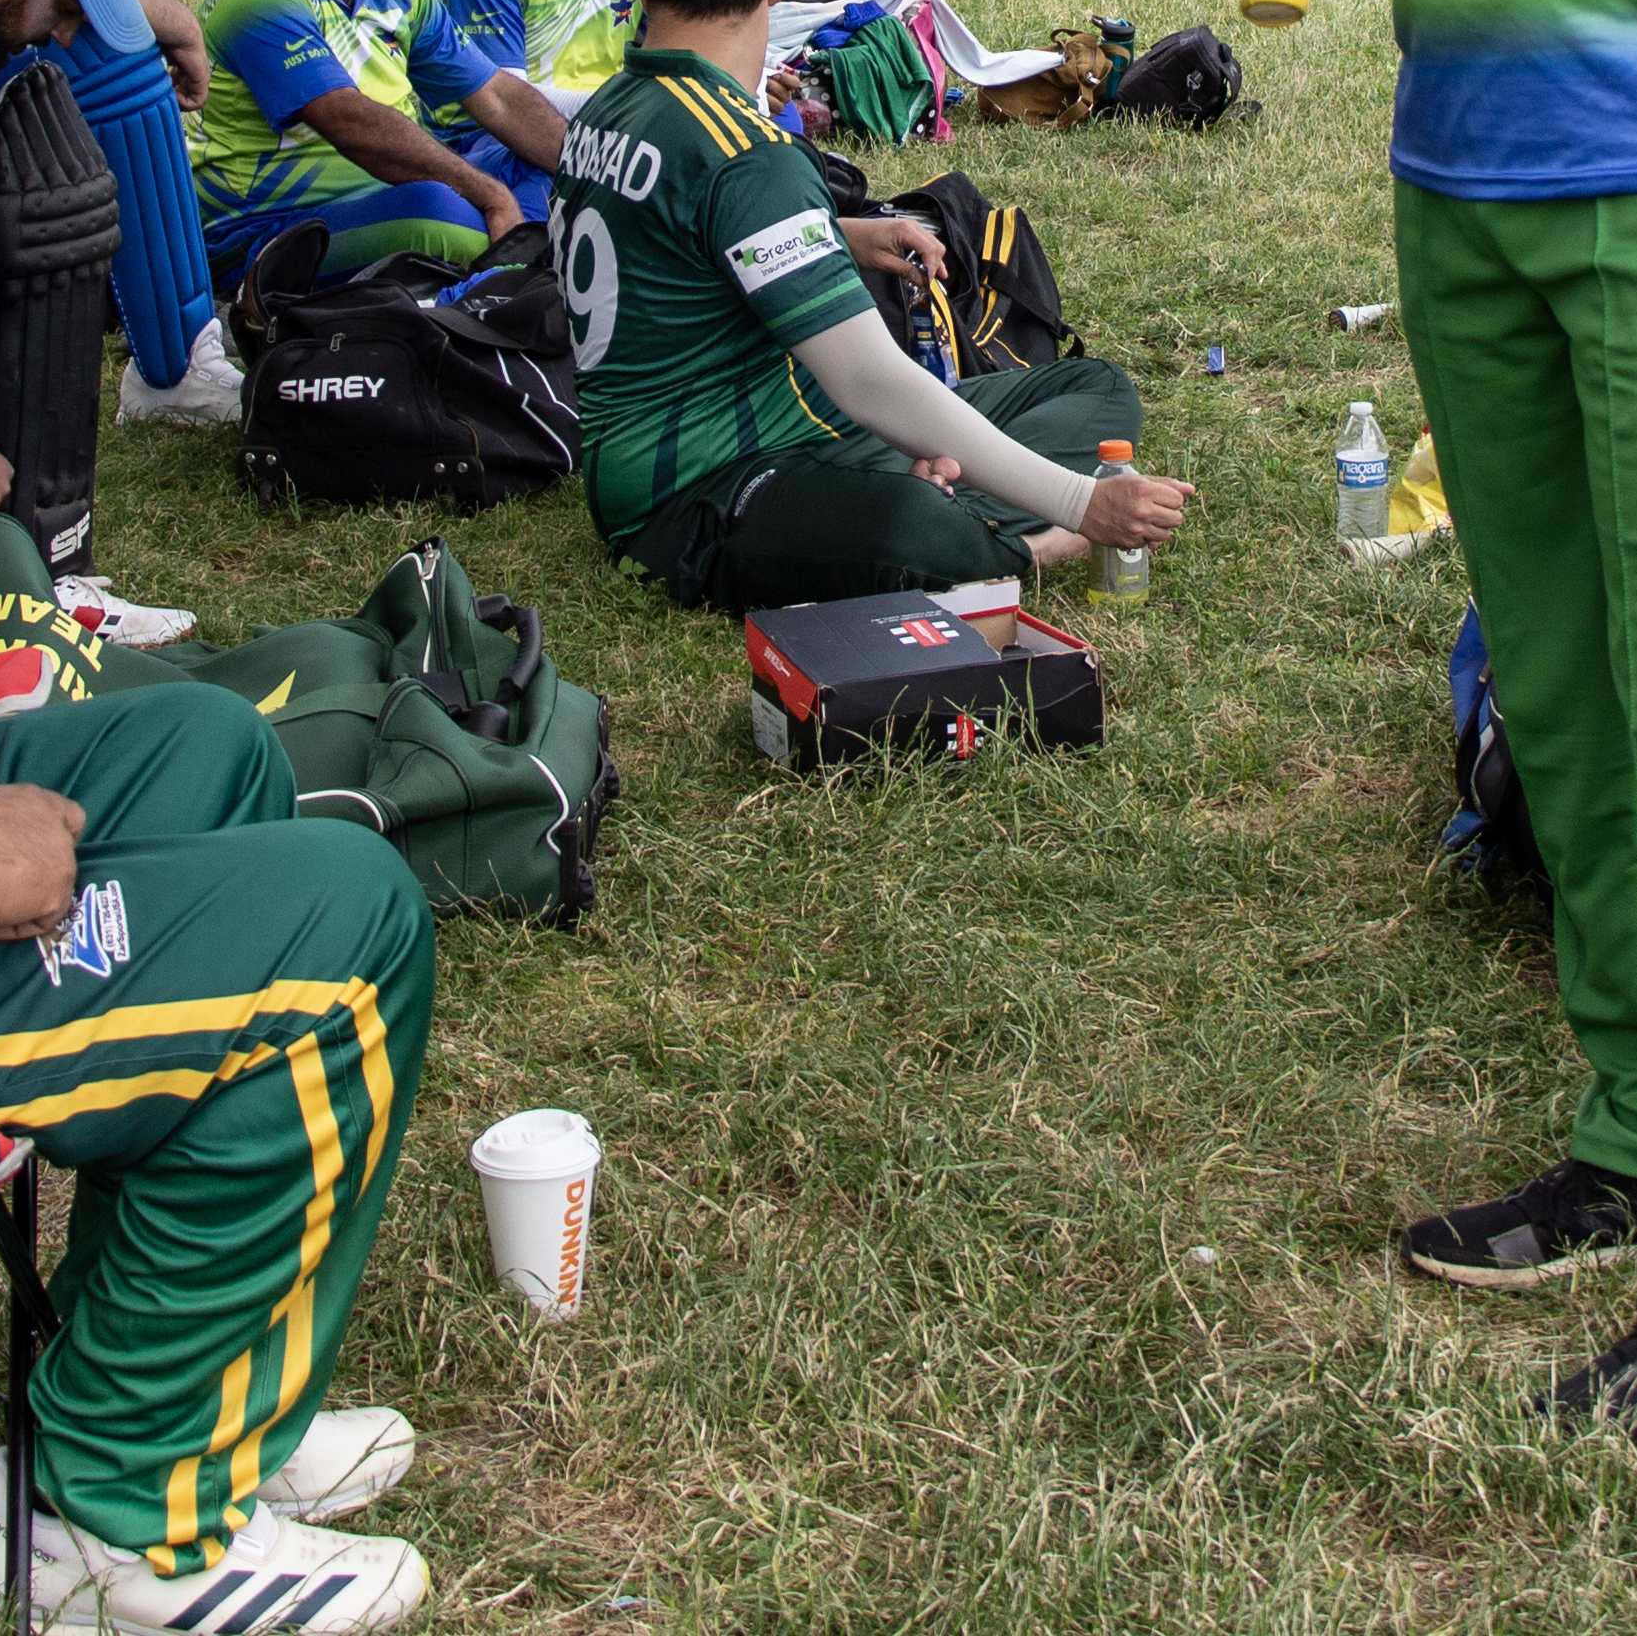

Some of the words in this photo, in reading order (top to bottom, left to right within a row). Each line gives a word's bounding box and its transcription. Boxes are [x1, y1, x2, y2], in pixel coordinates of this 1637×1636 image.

[284, 51, 307, 70] JUST
[752, 235, 804, 264] Green
[760, 254, 799, 277] Insurance
[277, 375, 386, 404] SHREY
[1342, 461, 1384, 476] niagara
